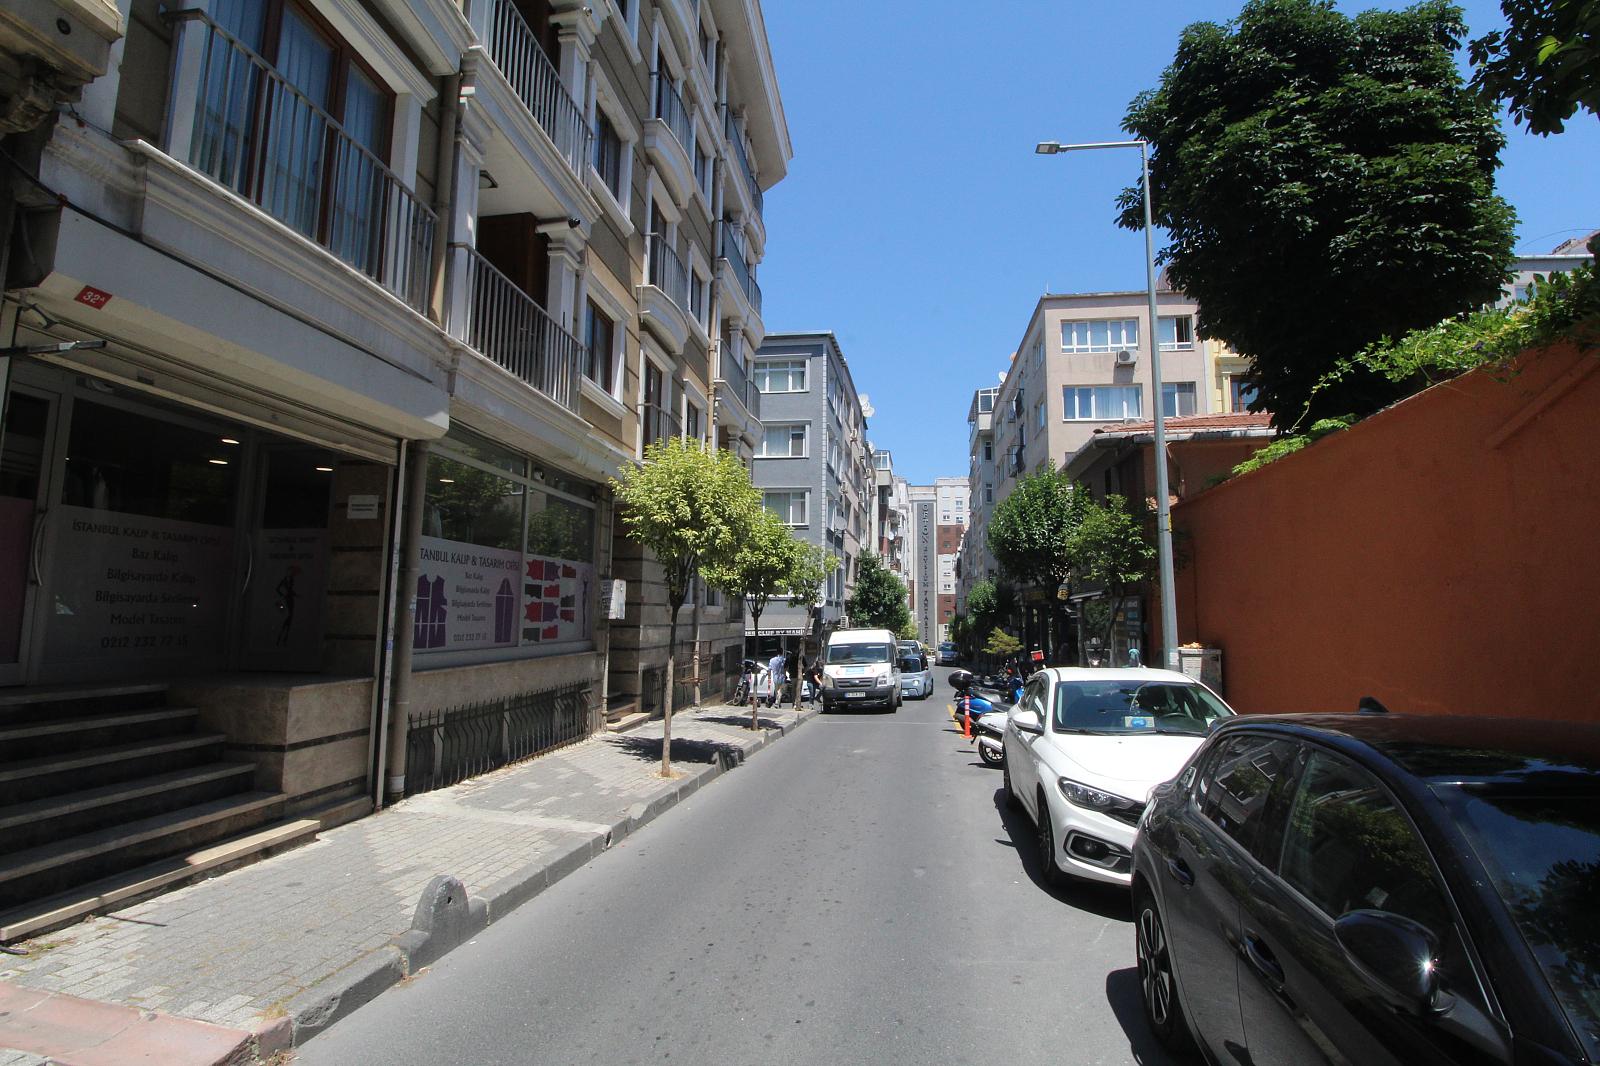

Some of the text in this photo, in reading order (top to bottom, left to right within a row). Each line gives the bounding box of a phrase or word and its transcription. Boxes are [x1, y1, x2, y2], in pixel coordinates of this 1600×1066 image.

[419, 547, 449, 563] TANBUL
[451, 552, 470, 565] KALIP
[471, 555, 478, 566] &
[479, 556, 504, 569] TASARIM
[110, 613, 145, 625] Model
